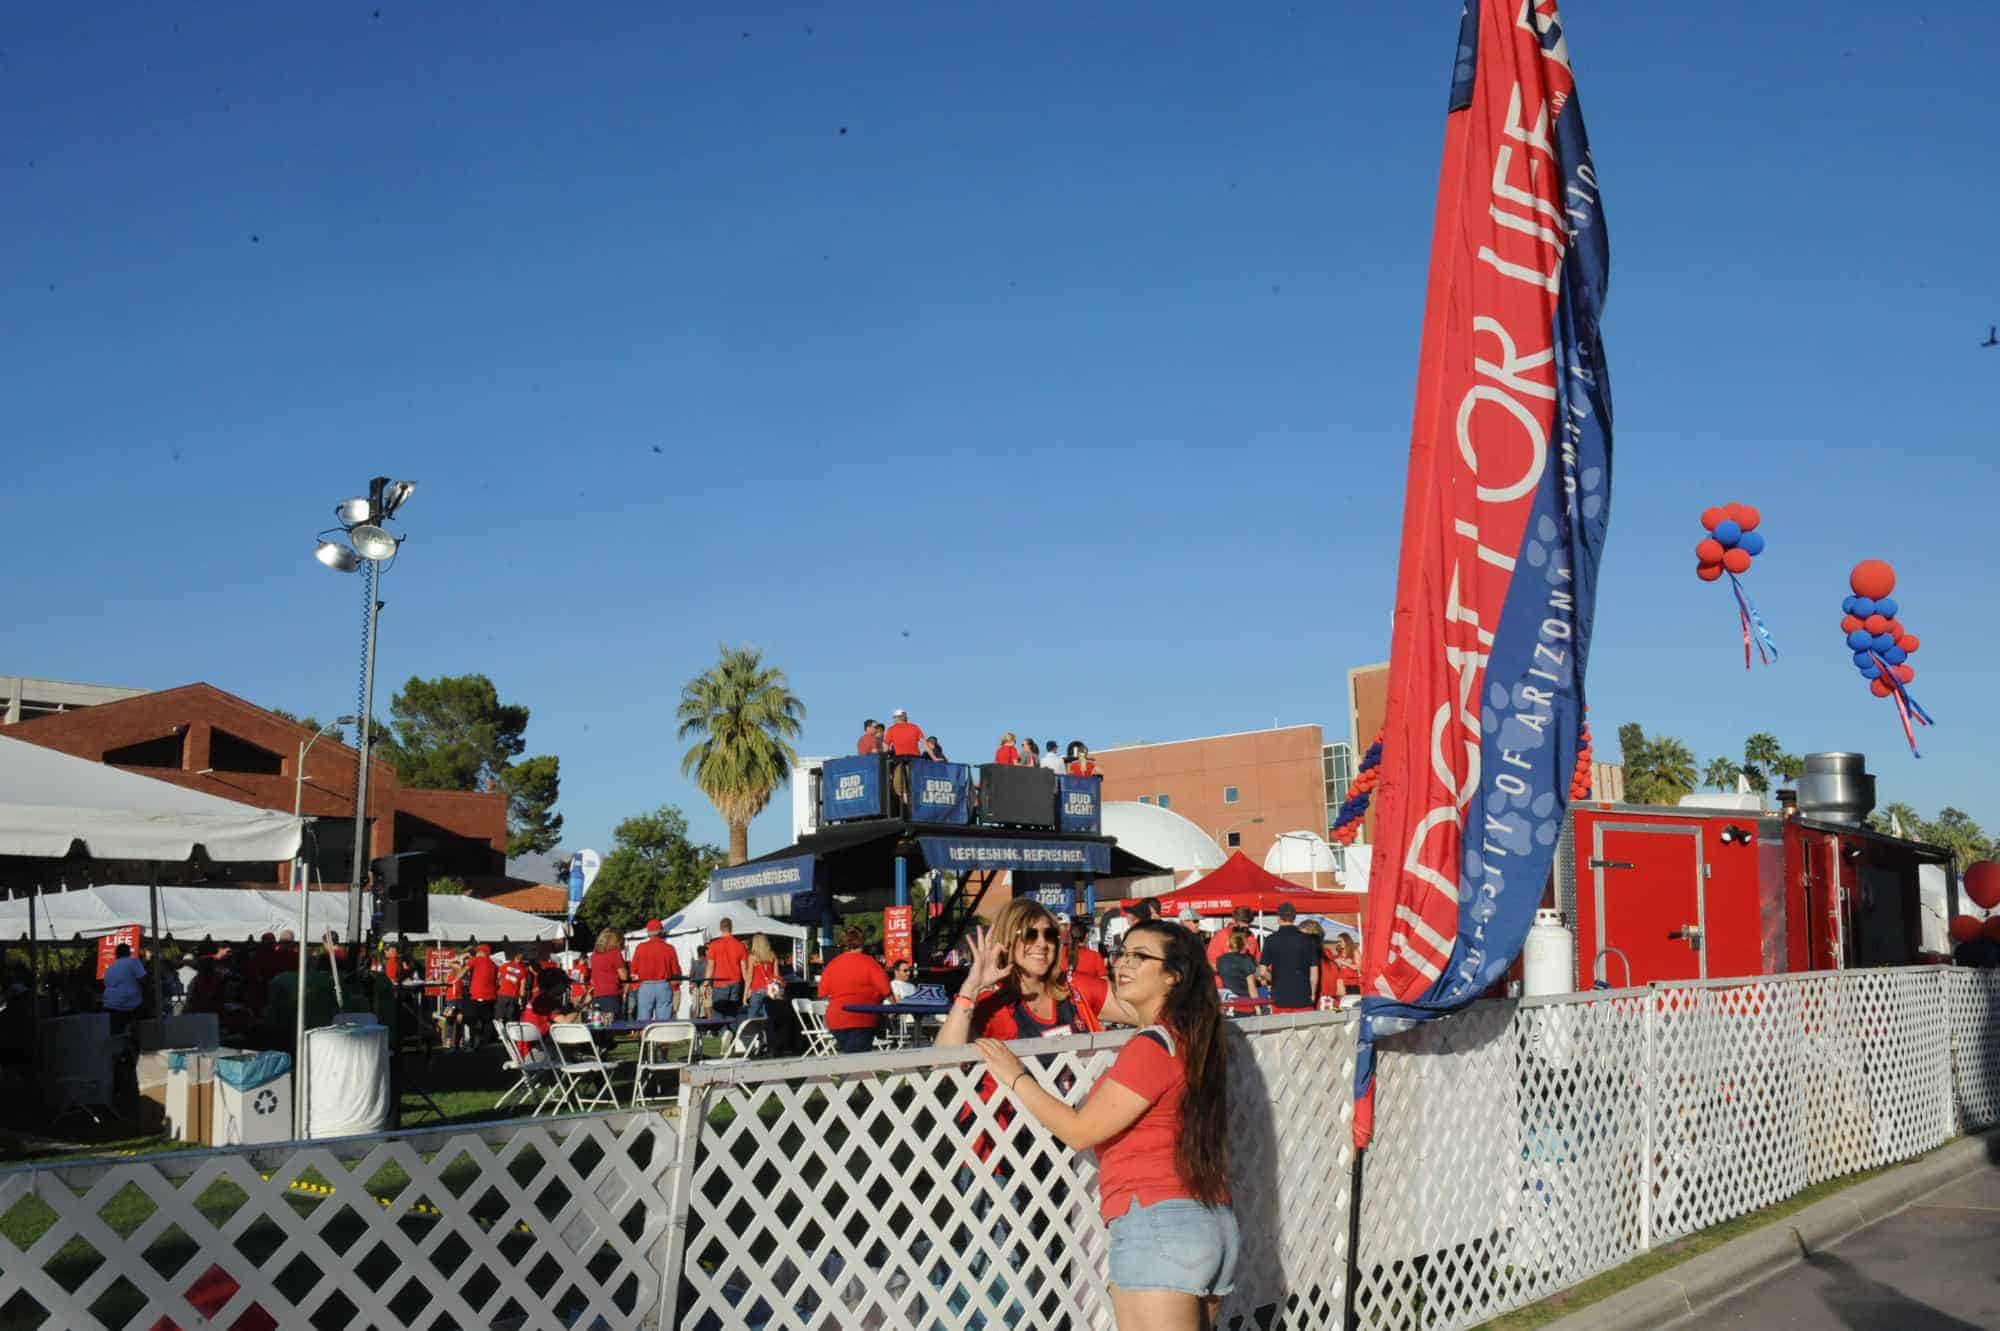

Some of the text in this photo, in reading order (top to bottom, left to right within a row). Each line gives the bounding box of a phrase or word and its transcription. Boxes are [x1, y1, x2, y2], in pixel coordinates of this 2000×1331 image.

[1374, 558, 1496, 1000] ILDCAT
[1477, 81, 1568, 294] LIFE
[1495, 748, 1533, 796] OF
[1515, 567, 1573, 733] ARIZONA
[839, 775, 861, 788] BUD
[926, 780, 952, 793] BUD
[835, 785, 865, 801] LIGHT
[922, 791, 957, 805] LIGHT
[1069, 793, 1091, 804] BUD
[1064, 803, 1095, 816] LIGHT
[1040, 883, 1063, 894] BUD
[1035, 893, 1066, 905] LIGHT
[888, 919, 907, 930] LIFE
[106, 935, 133, 946] LIFE
